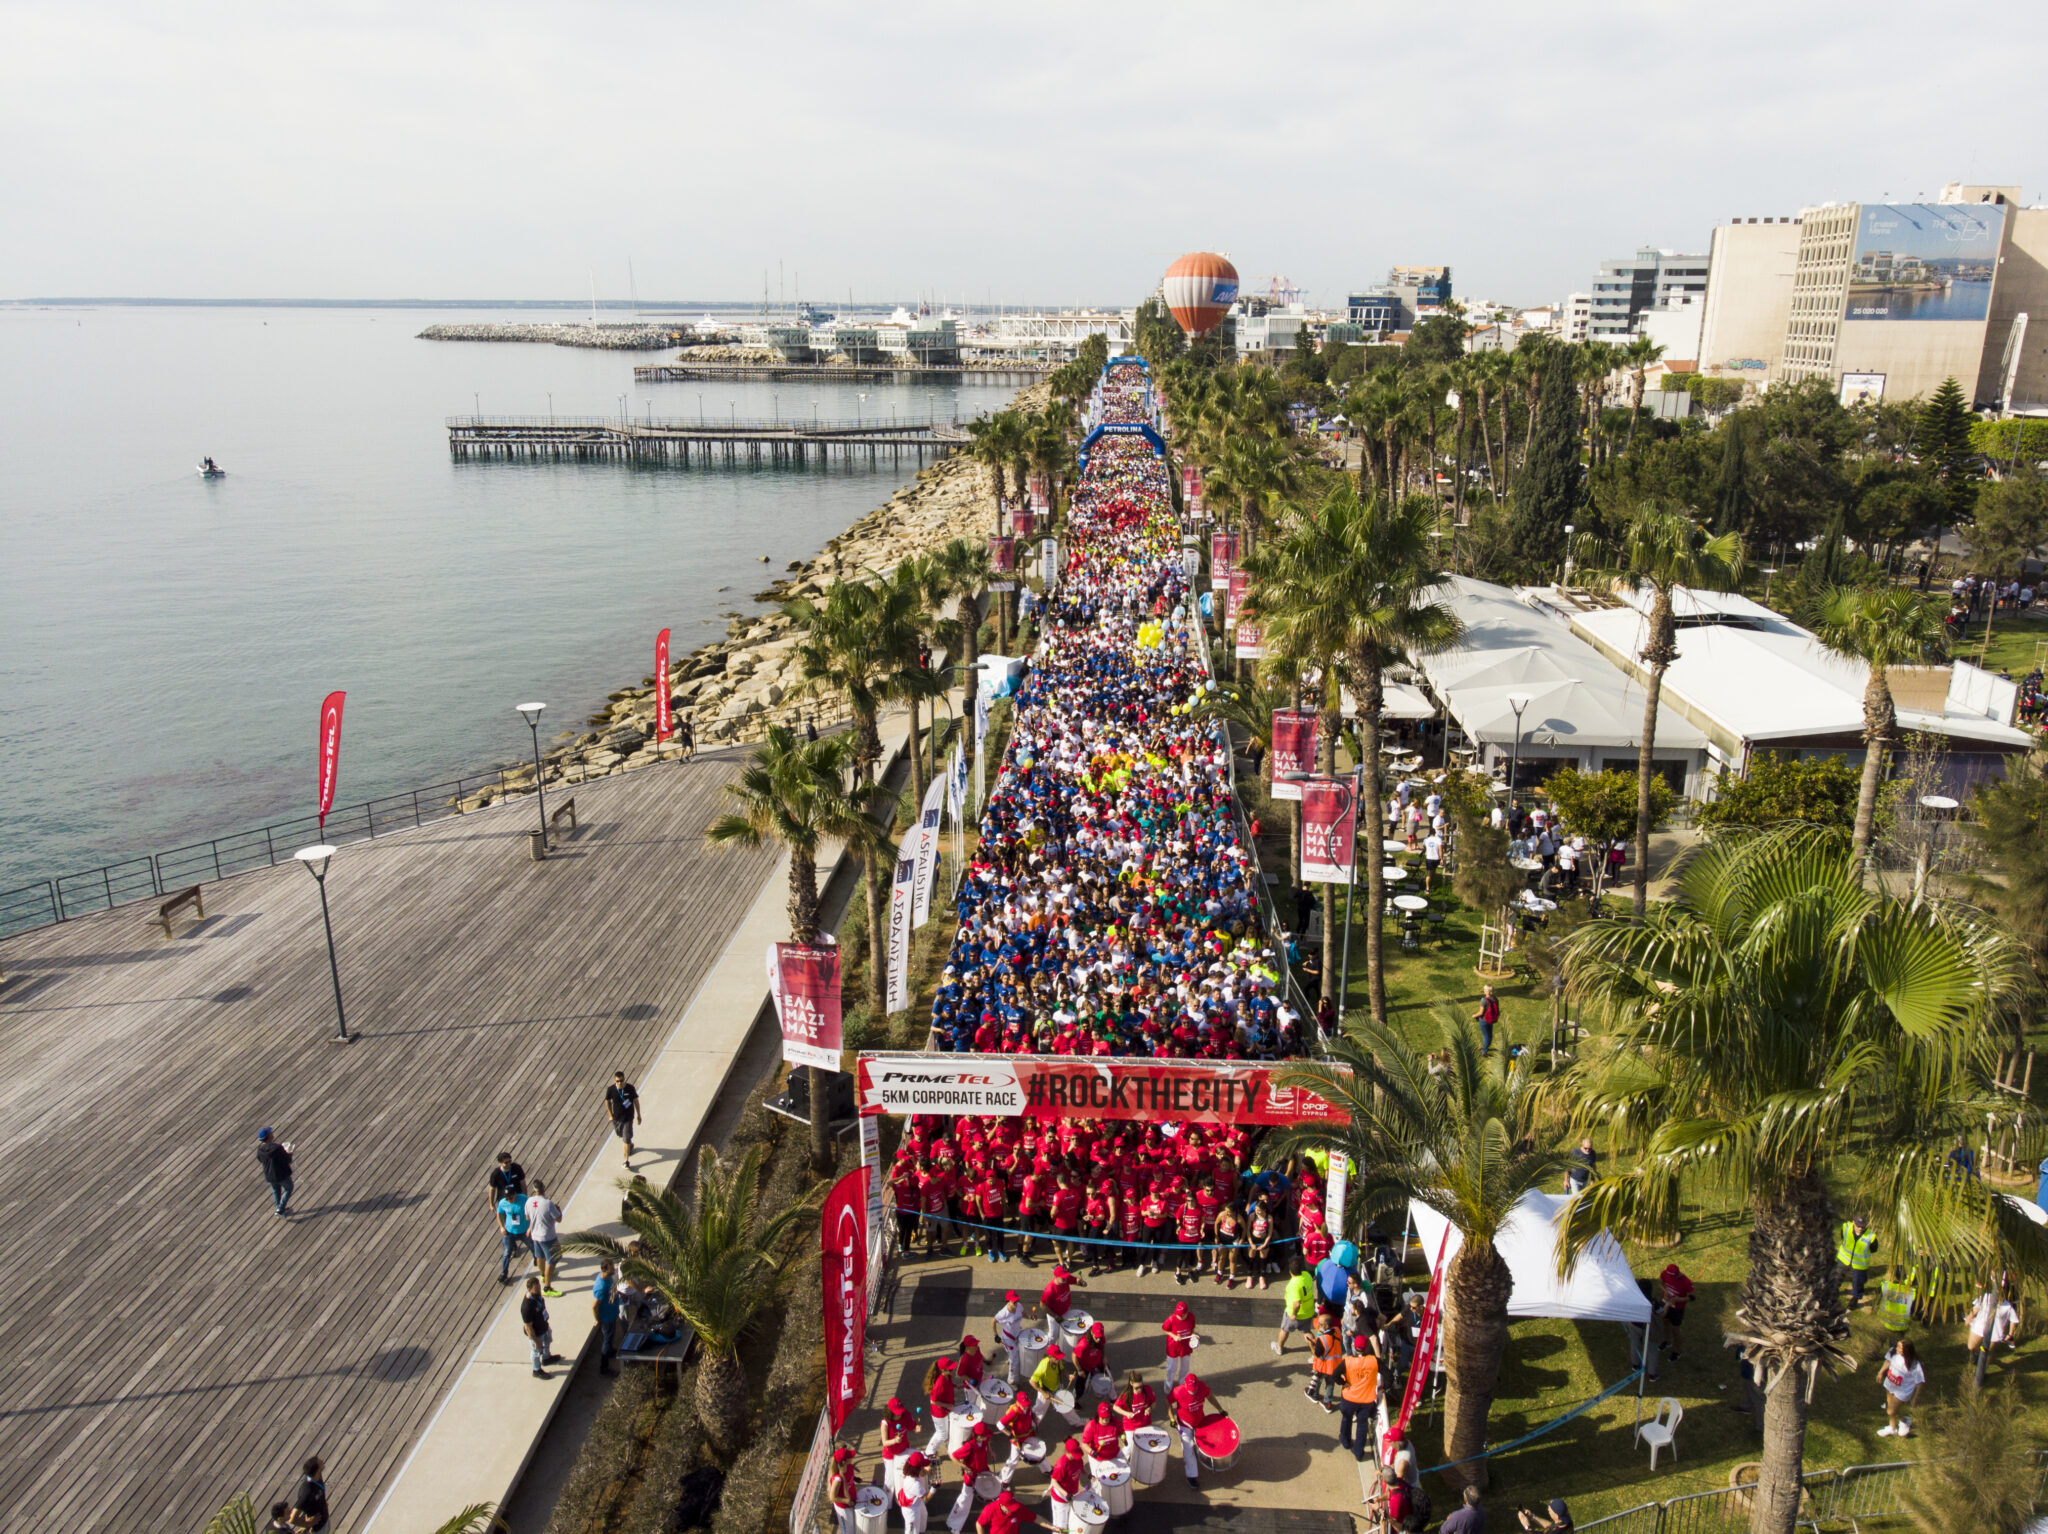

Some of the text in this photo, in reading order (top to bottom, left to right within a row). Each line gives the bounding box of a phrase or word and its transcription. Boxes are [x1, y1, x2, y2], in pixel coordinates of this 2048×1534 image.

[1945, 220, 1990, 241] SEA
[784, 994, 816, 1012] ΕΛΑ
[785, 1007, 825, 1026] ΜΑΖΙ
[786, 1020, 818, 1039] ΜΑΣ
[882, 1089, 1017, 1106] 5KM CORPORATE RACE
[1028, 1073, 1261, 1114] #ROCKTHECITY
[840, 1235, 854, 1400] PRIMETEL
